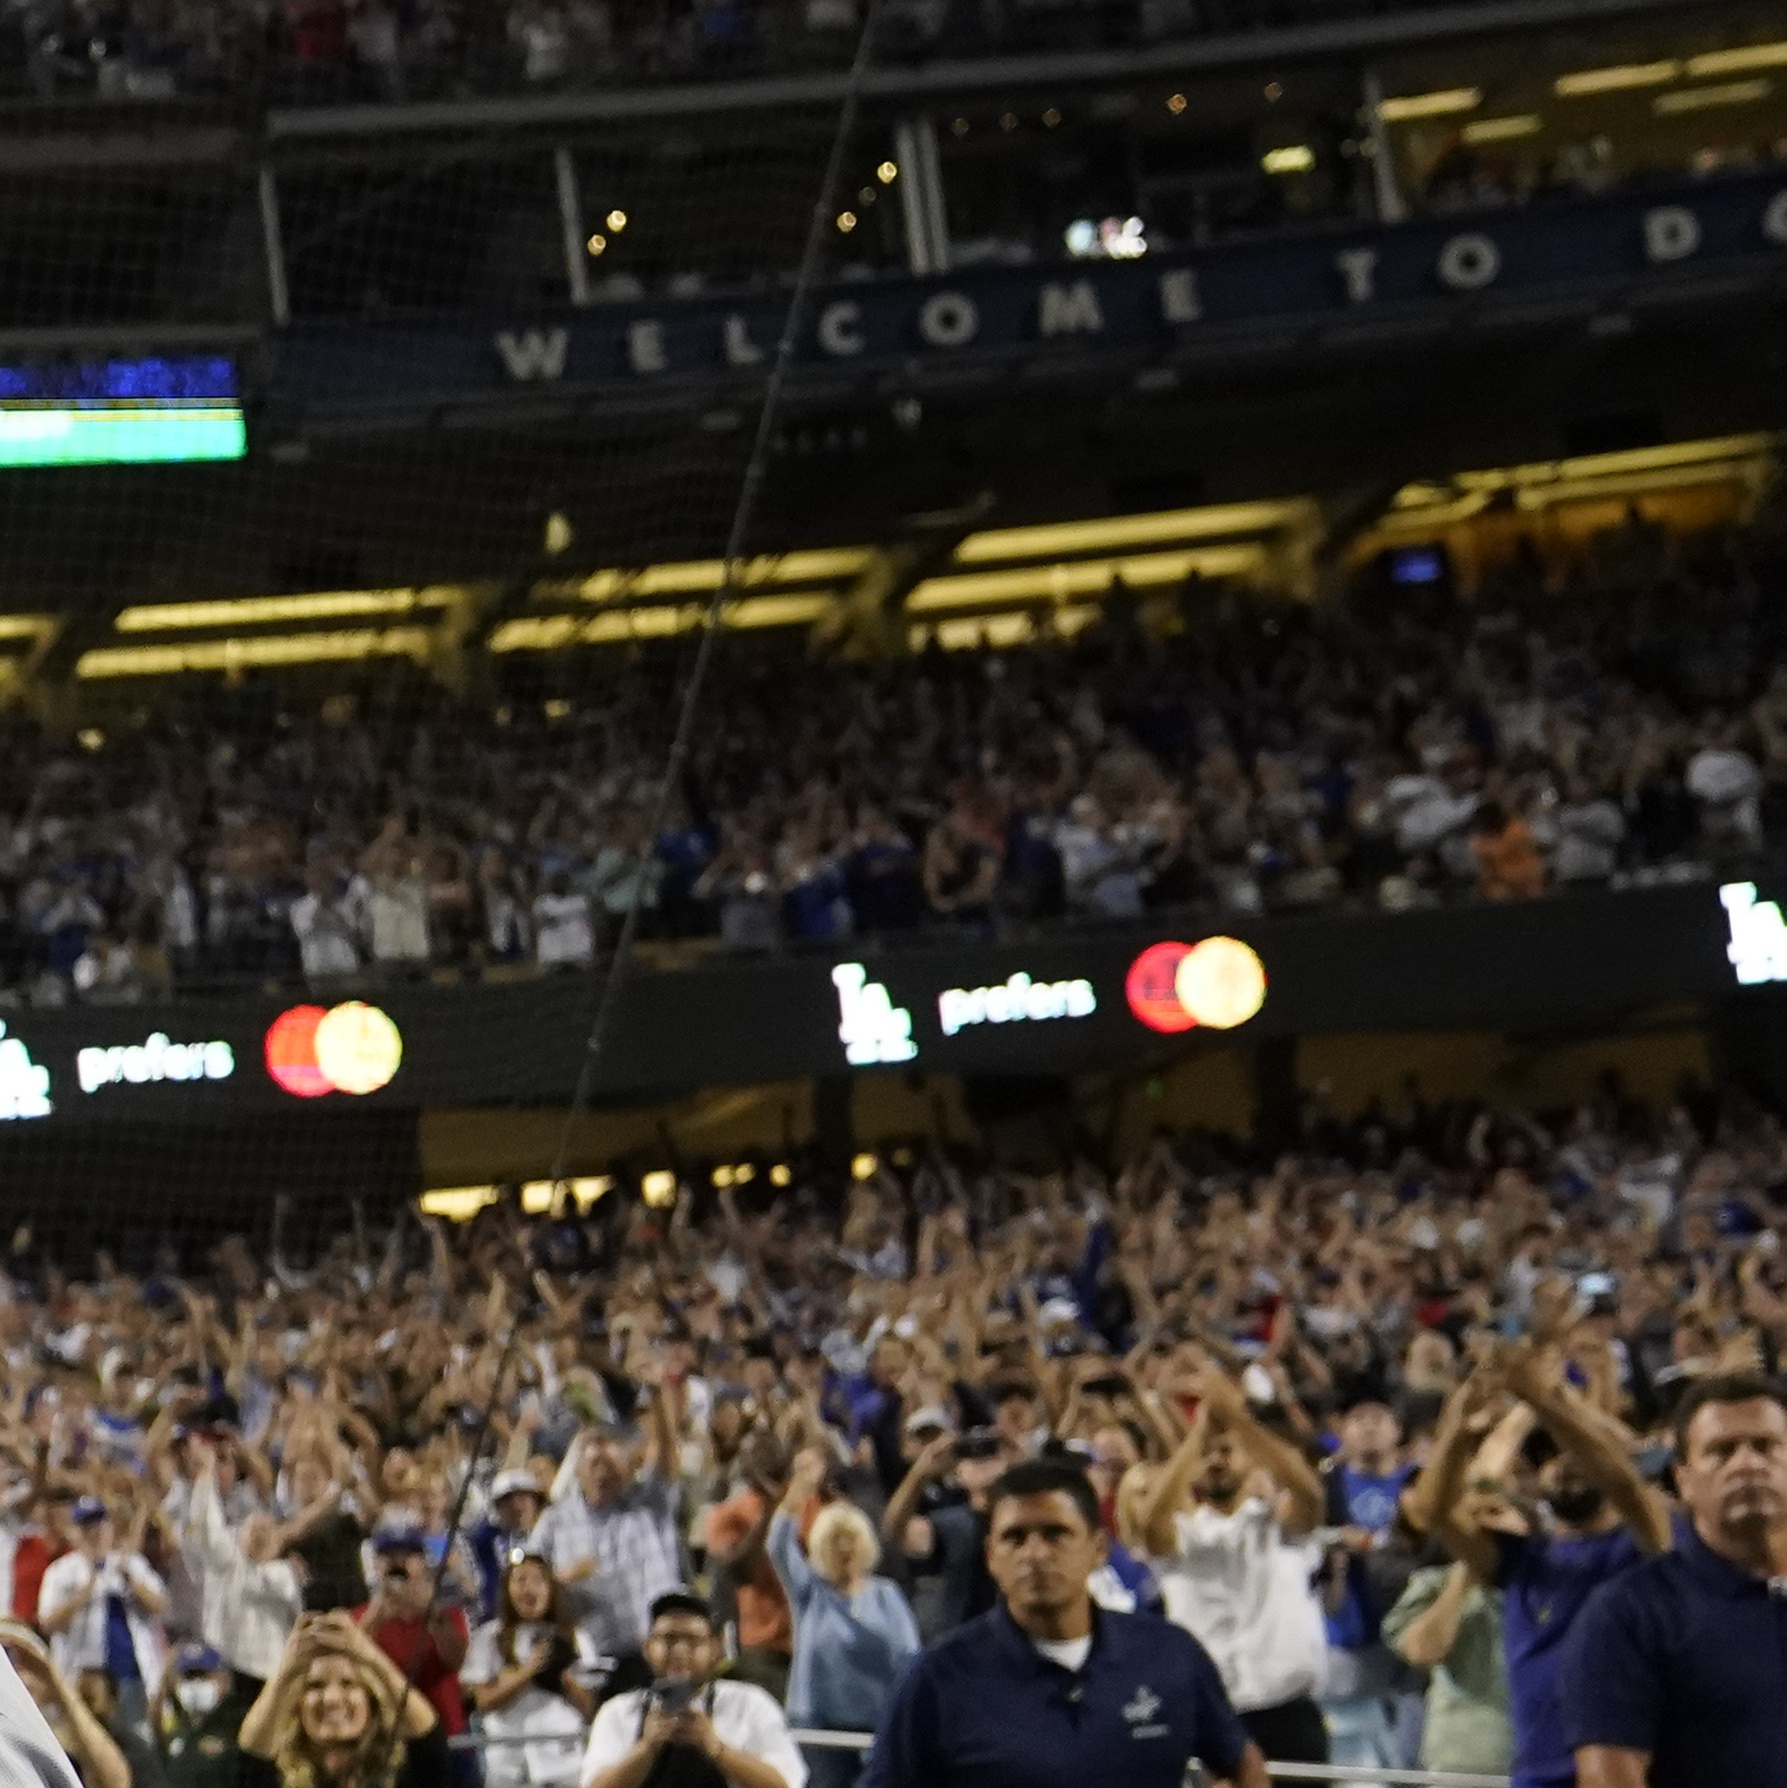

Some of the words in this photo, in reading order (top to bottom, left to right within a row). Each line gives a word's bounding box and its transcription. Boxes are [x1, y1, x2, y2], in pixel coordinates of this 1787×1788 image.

[493, 268, 1204, 382] WELCOME
[1336, 232, 1501, 301] TO
[938, 972, 1096, 1037] prefers
[78, 1032, 234, 1093] prefers
